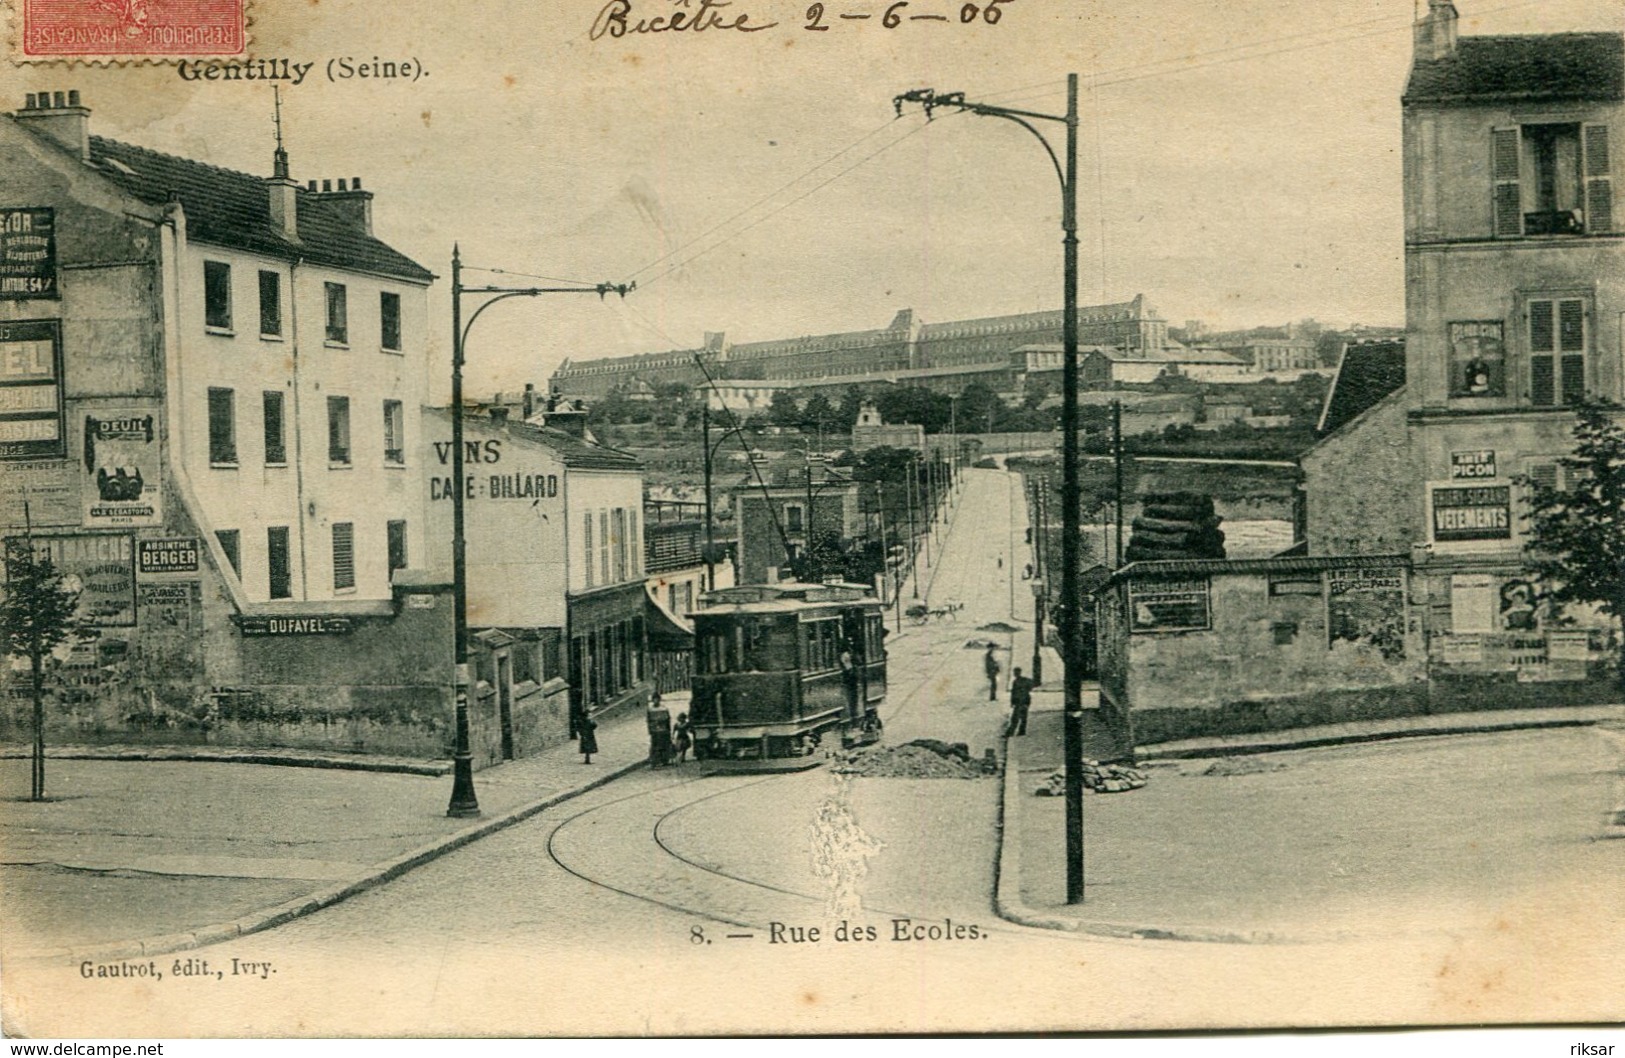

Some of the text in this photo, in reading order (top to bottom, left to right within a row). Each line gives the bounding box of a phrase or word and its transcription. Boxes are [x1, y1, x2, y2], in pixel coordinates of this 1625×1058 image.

[177, 56, 429, 86] Gentilly (Seine).
[100, 420, 147, 432] DEUIL
[433, 439, 501, 465] VNS
[1452, 464, 1495, 477] PICON
[431, 472, 557, 501] CAÉ BILLARD
[145, 541, 192, 551] ABSINTHE
[142, 550, 197, 566] BERGER
[270, 619, 326, 633] DUFAYEL
[691, 927, 711, 944] 8.
[770, 922, 819, 943] Rue
[835, 921, 876, 941] des
[892, 919, 987, 941] Ecoles.
[80, 957, 278, 981] Gautrot, édit., Ivry.
